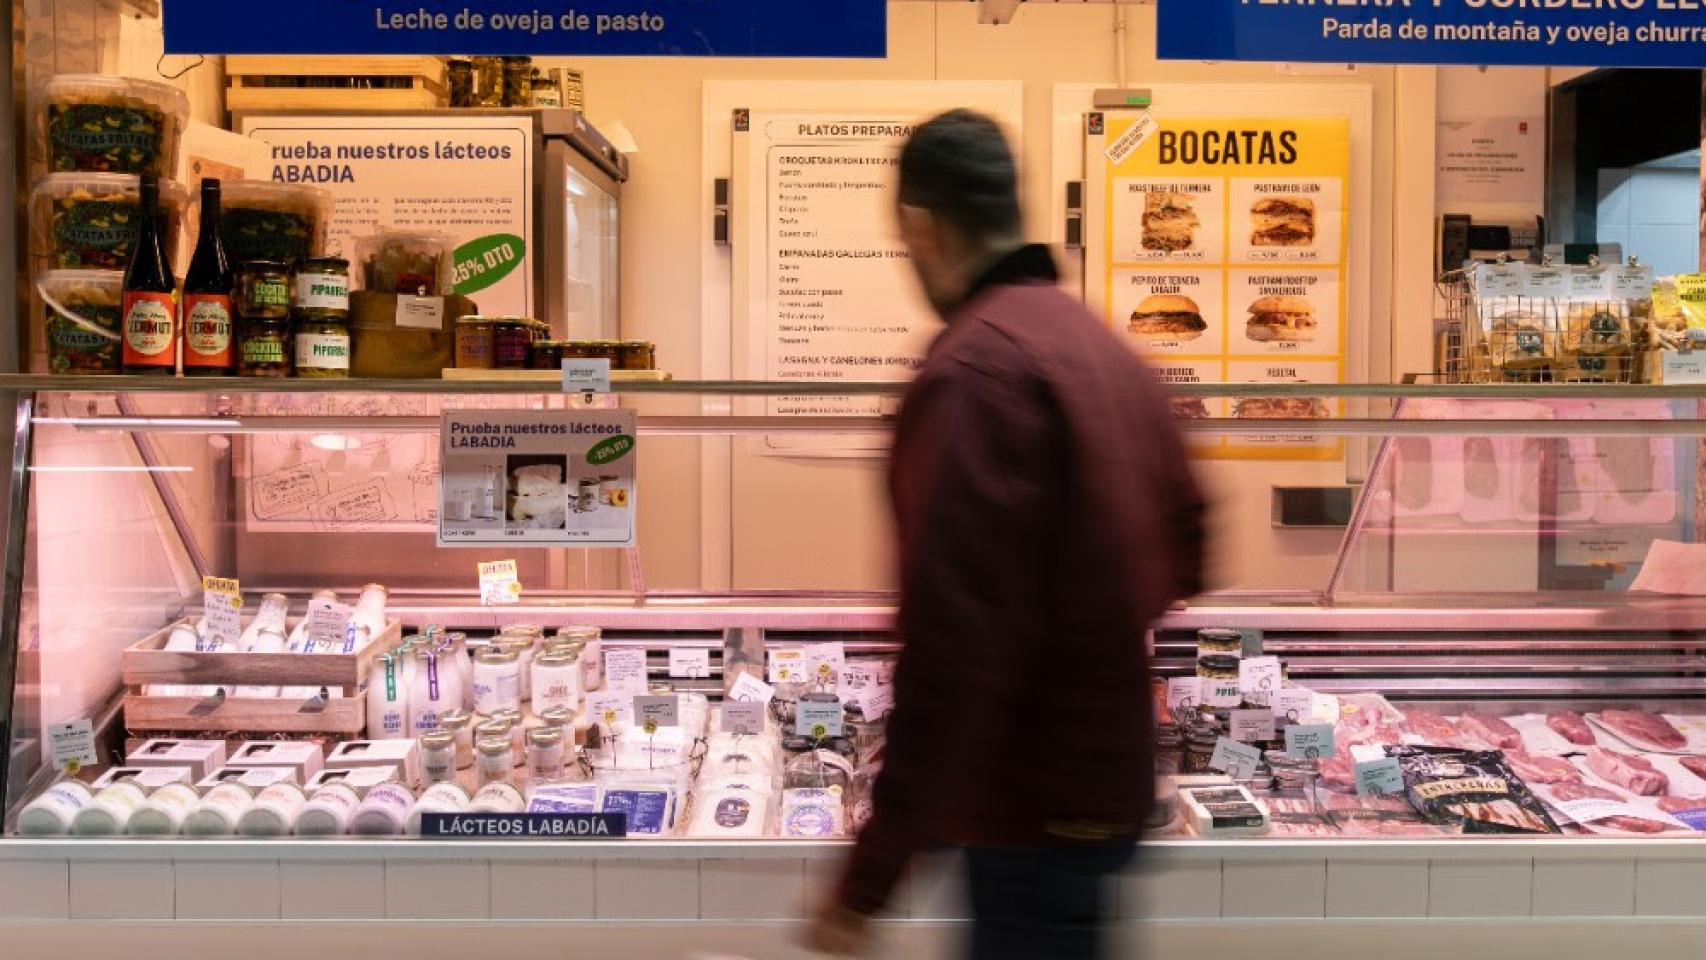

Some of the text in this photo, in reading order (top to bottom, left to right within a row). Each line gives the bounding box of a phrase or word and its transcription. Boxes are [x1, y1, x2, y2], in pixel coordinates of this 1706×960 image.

[376, 7, 665, 35] Leche de oveja de pasto
[1323, 17, 1392, 39] Parda
[1398, 18, 1428, 40] de
[1434, 20, 1540, 41] montaña
[1546, 26, 1561, 45] y
[1566, 21, 1629, 45] oveja
[798, 124, 849, 137] PLATOS
[272, 141, 511, 160] rueba nuestros lácteos
[1158, 130, 1298, 165] BOCATAS
[272, 164, 354, 184] ABADIA
[485, 247, 516, 269] DTO
[451, 422, 622, 434] Prueba nuestros lácteos
[439, 815, 610, 836] LÁCTEOS LABADÍA
